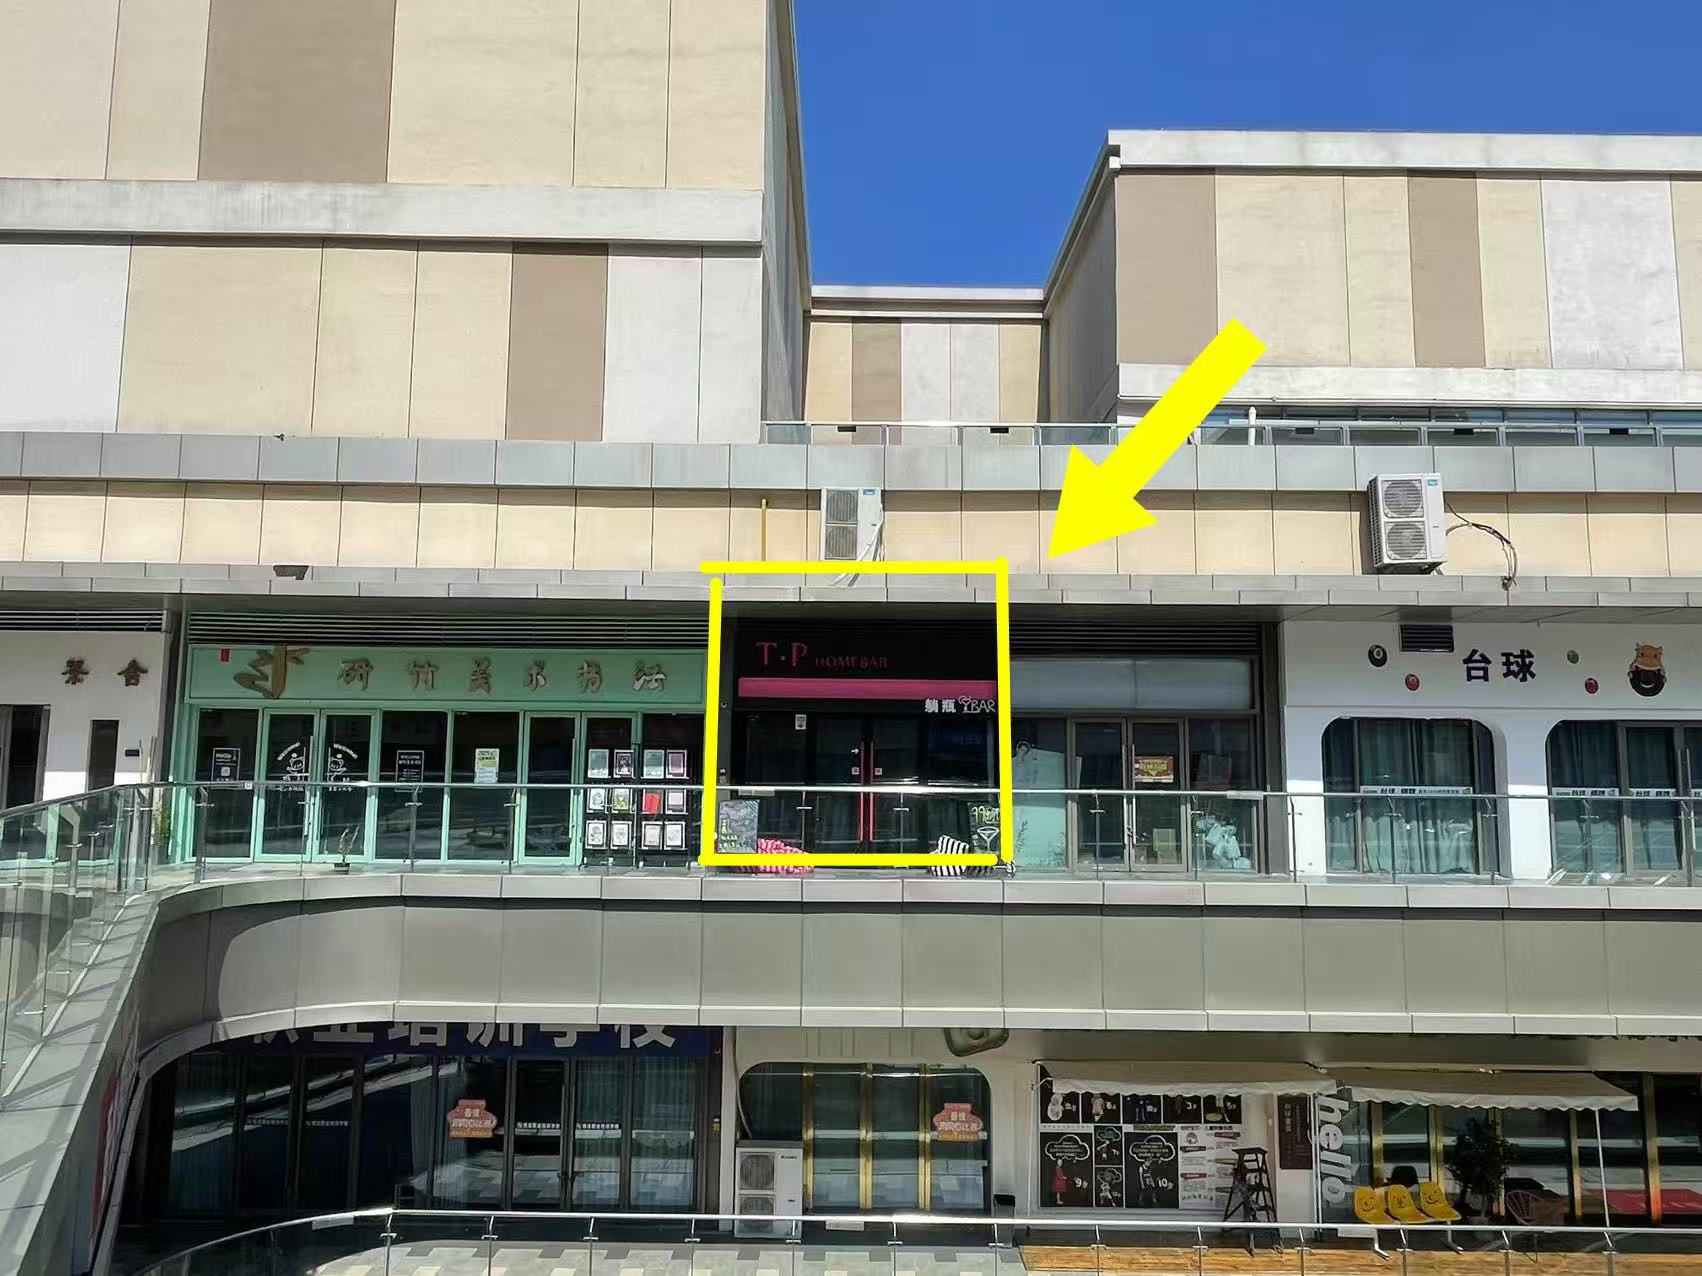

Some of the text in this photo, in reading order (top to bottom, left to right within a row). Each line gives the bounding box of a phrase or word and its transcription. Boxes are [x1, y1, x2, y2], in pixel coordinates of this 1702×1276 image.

[815, 655, 888, 669] HOMEBAR
[1462, 648, 1537, 683] 台球
[1317, 1095, 1352, 1204] hello
